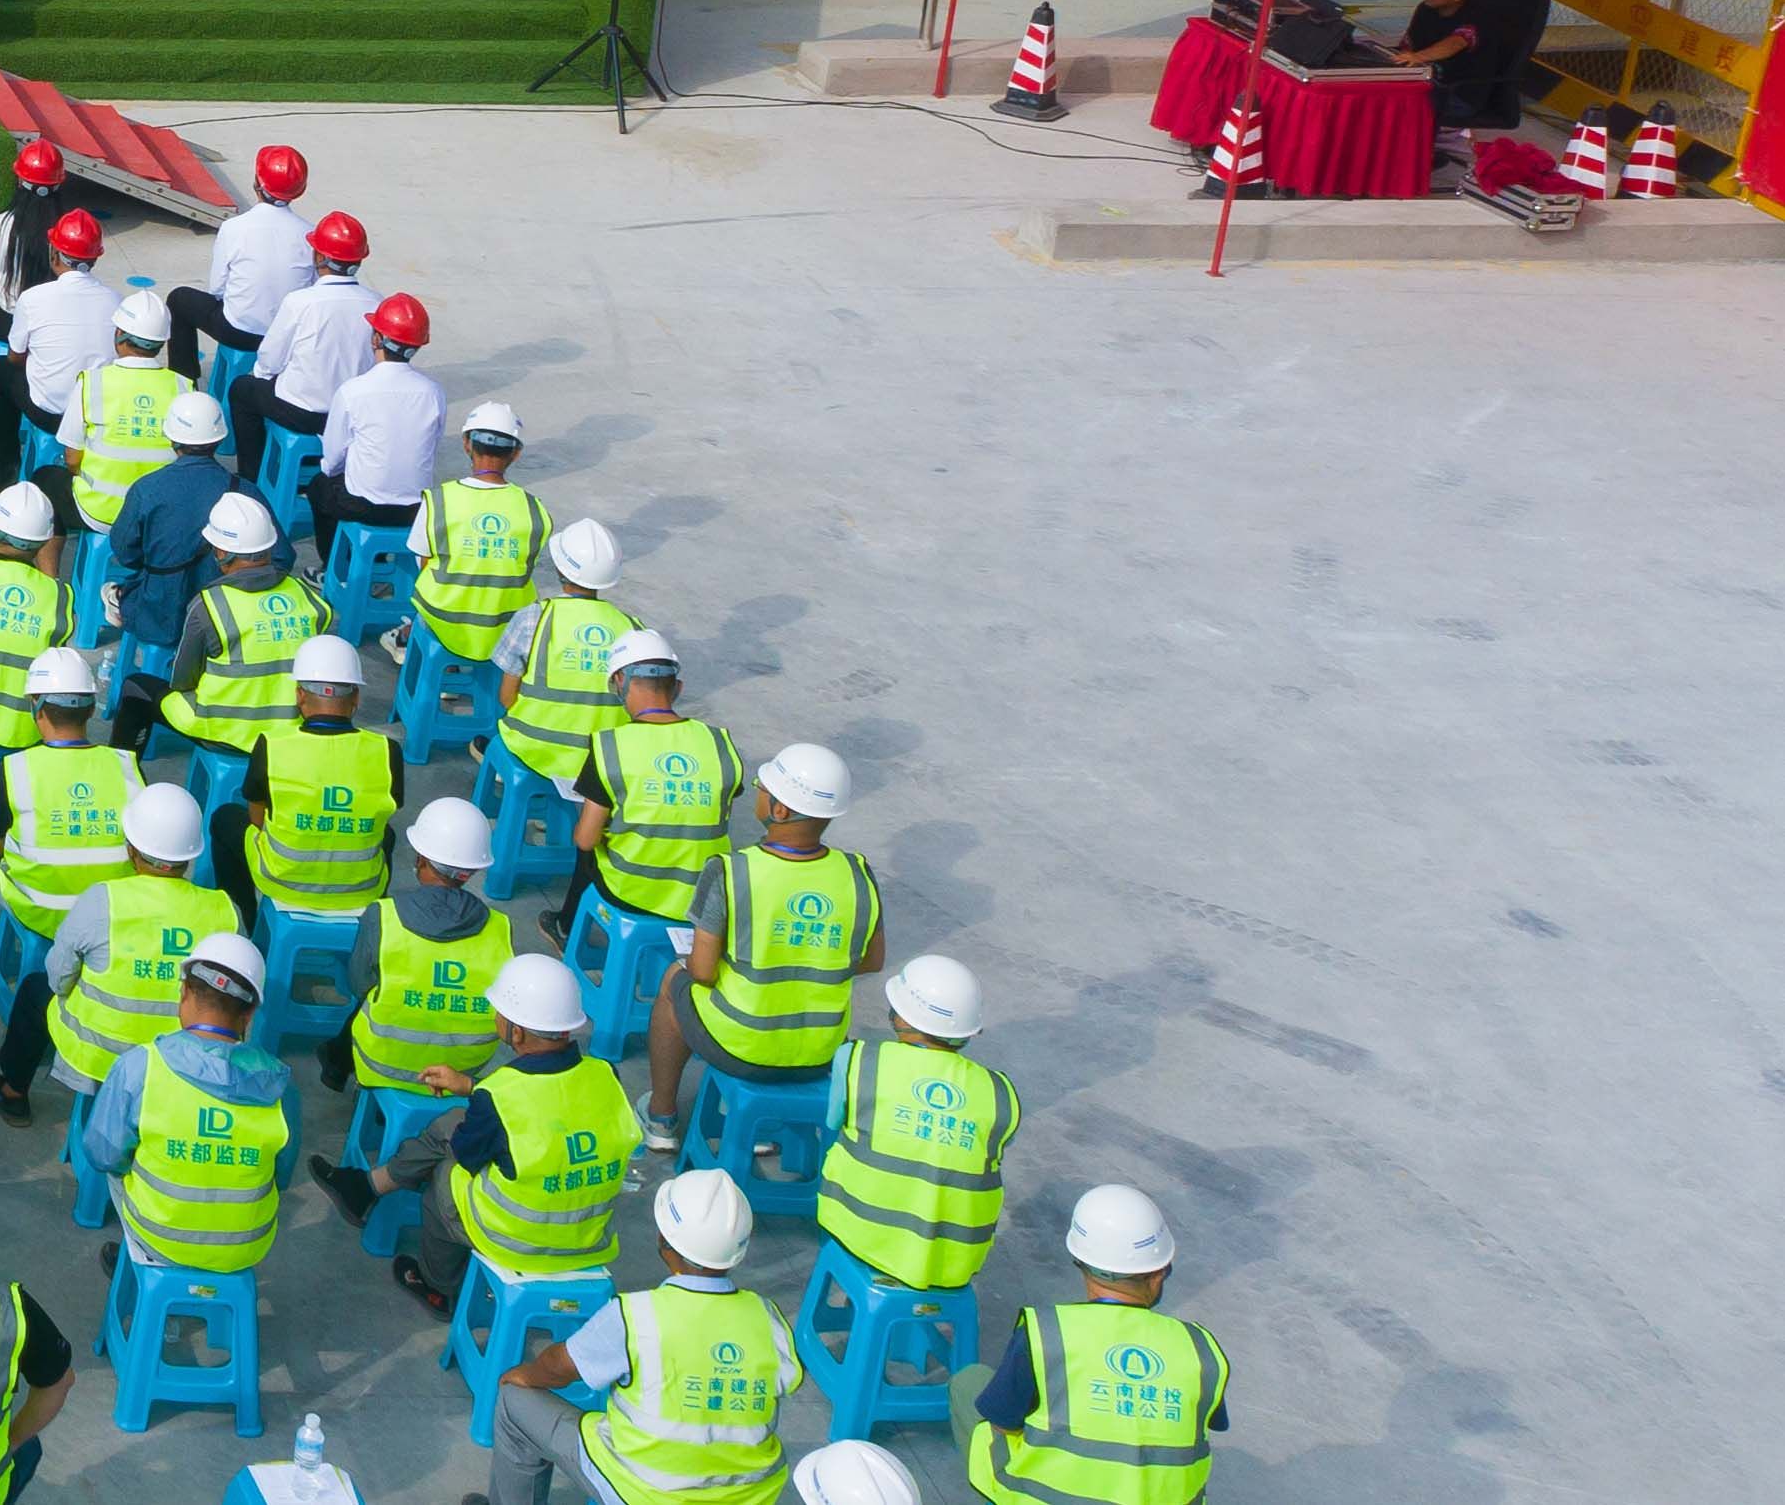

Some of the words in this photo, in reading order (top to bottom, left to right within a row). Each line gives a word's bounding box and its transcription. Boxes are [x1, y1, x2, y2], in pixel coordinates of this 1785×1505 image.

[296, 814, 375, 834] 联都监理
[404, 990, 490, 1015] 联都监理
[894, 1105, 977, 1135] 云南建投
[892, 1121, 974, 1151] 二建公司
[167, 1139, 261, 1168] 联都监理
[543, 1160, 622, 1194] 联都监理
[684, 1377, 767, 1395] 云南建投
[1090, 1380, 1183, 1405] 云南建投
[684, 1395, 766, 1412] 二建公司
[1090, 1398, 1181, 1422] 二建公司
